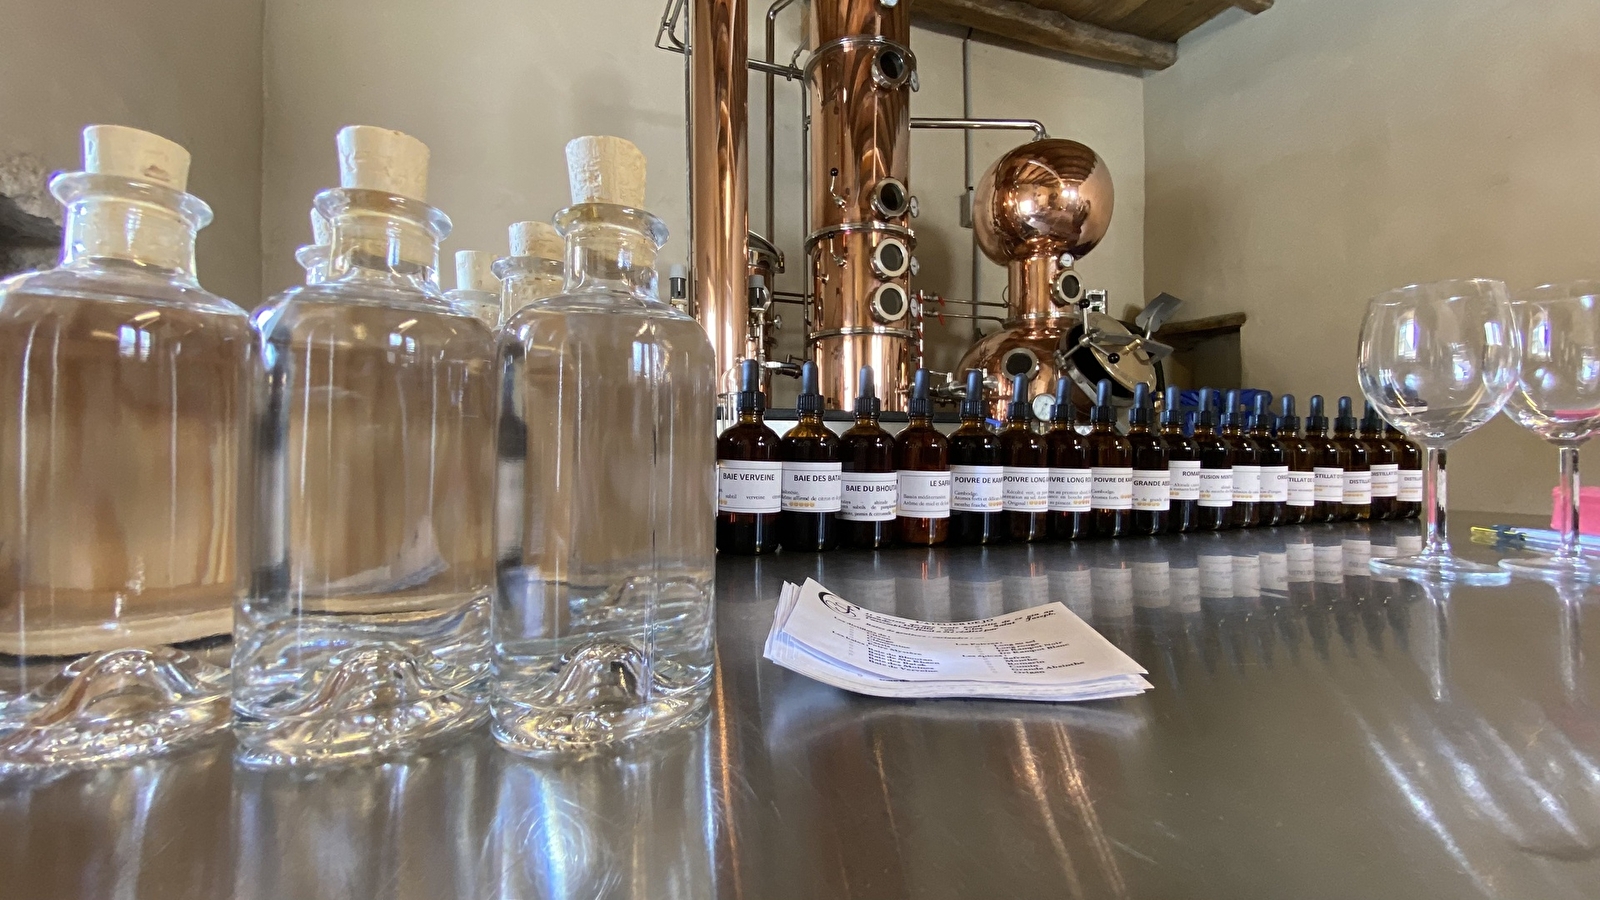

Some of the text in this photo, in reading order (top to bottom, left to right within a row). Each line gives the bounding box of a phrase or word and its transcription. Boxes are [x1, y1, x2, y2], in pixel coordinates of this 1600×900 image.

[723, 472, 775, 481] BAIE VERVEINE
[794, 474, 811, 482] BAIE
